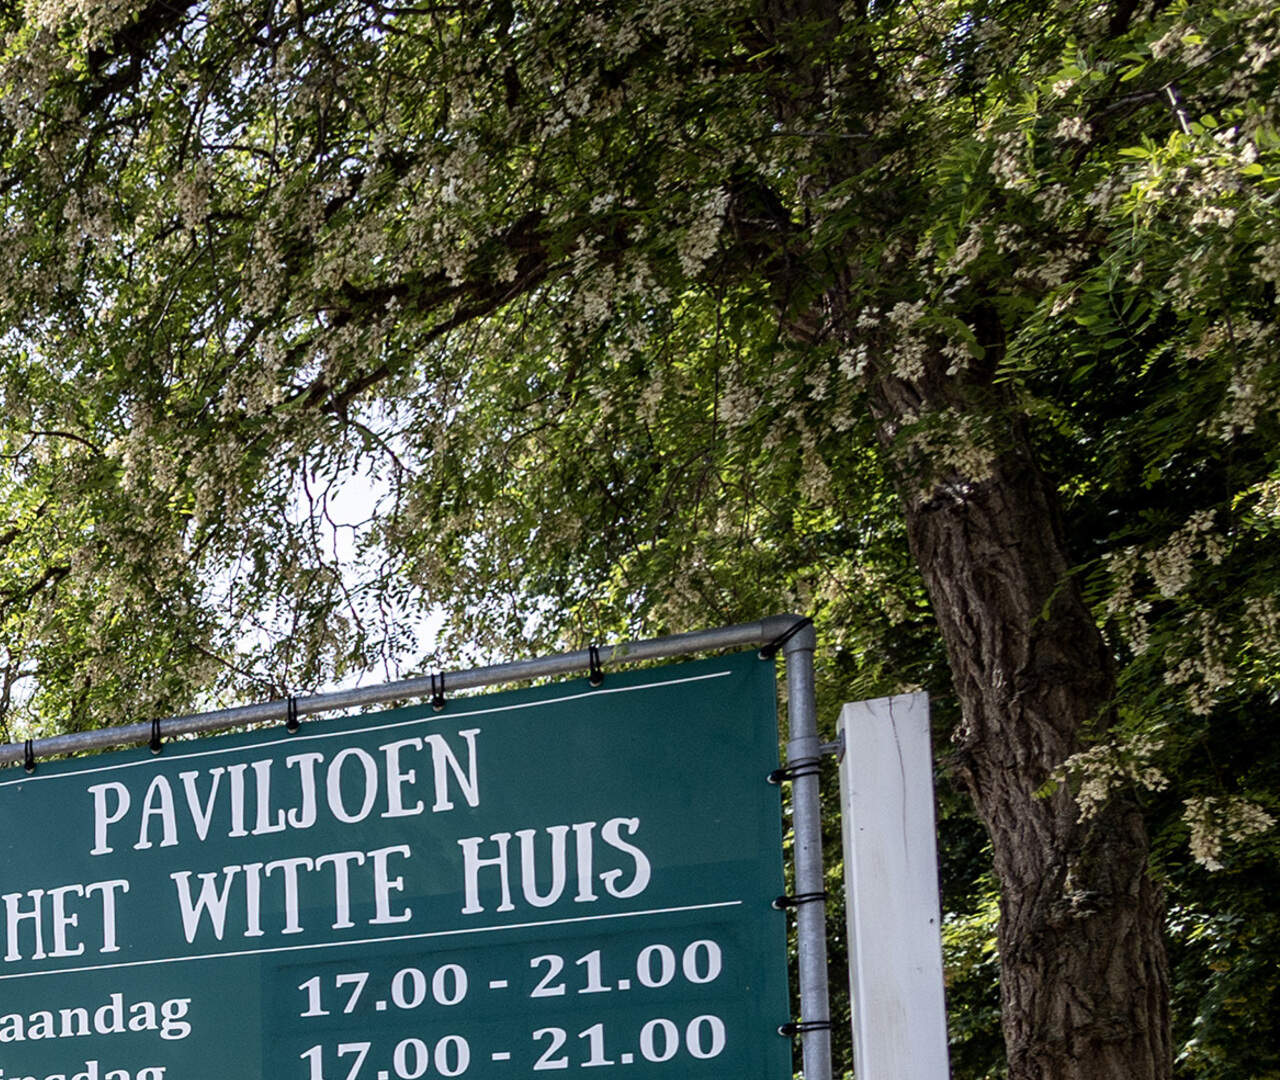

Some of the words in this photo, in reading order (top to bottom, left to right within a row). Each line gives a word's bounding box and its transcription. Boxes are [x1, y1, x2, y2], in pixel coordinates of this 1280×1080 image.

[88, 729, 481, 856] PAVILJOEN
[2, 880, 130, 962] HET
[169, 845, 412, 944] WITTE
[457, 817, 651, 915] HUIS
[298, 963, 468, 1017] 17.00
[530, 939, 722, 998] 21.00
[532, 1014, 726, 1071] 21.00
